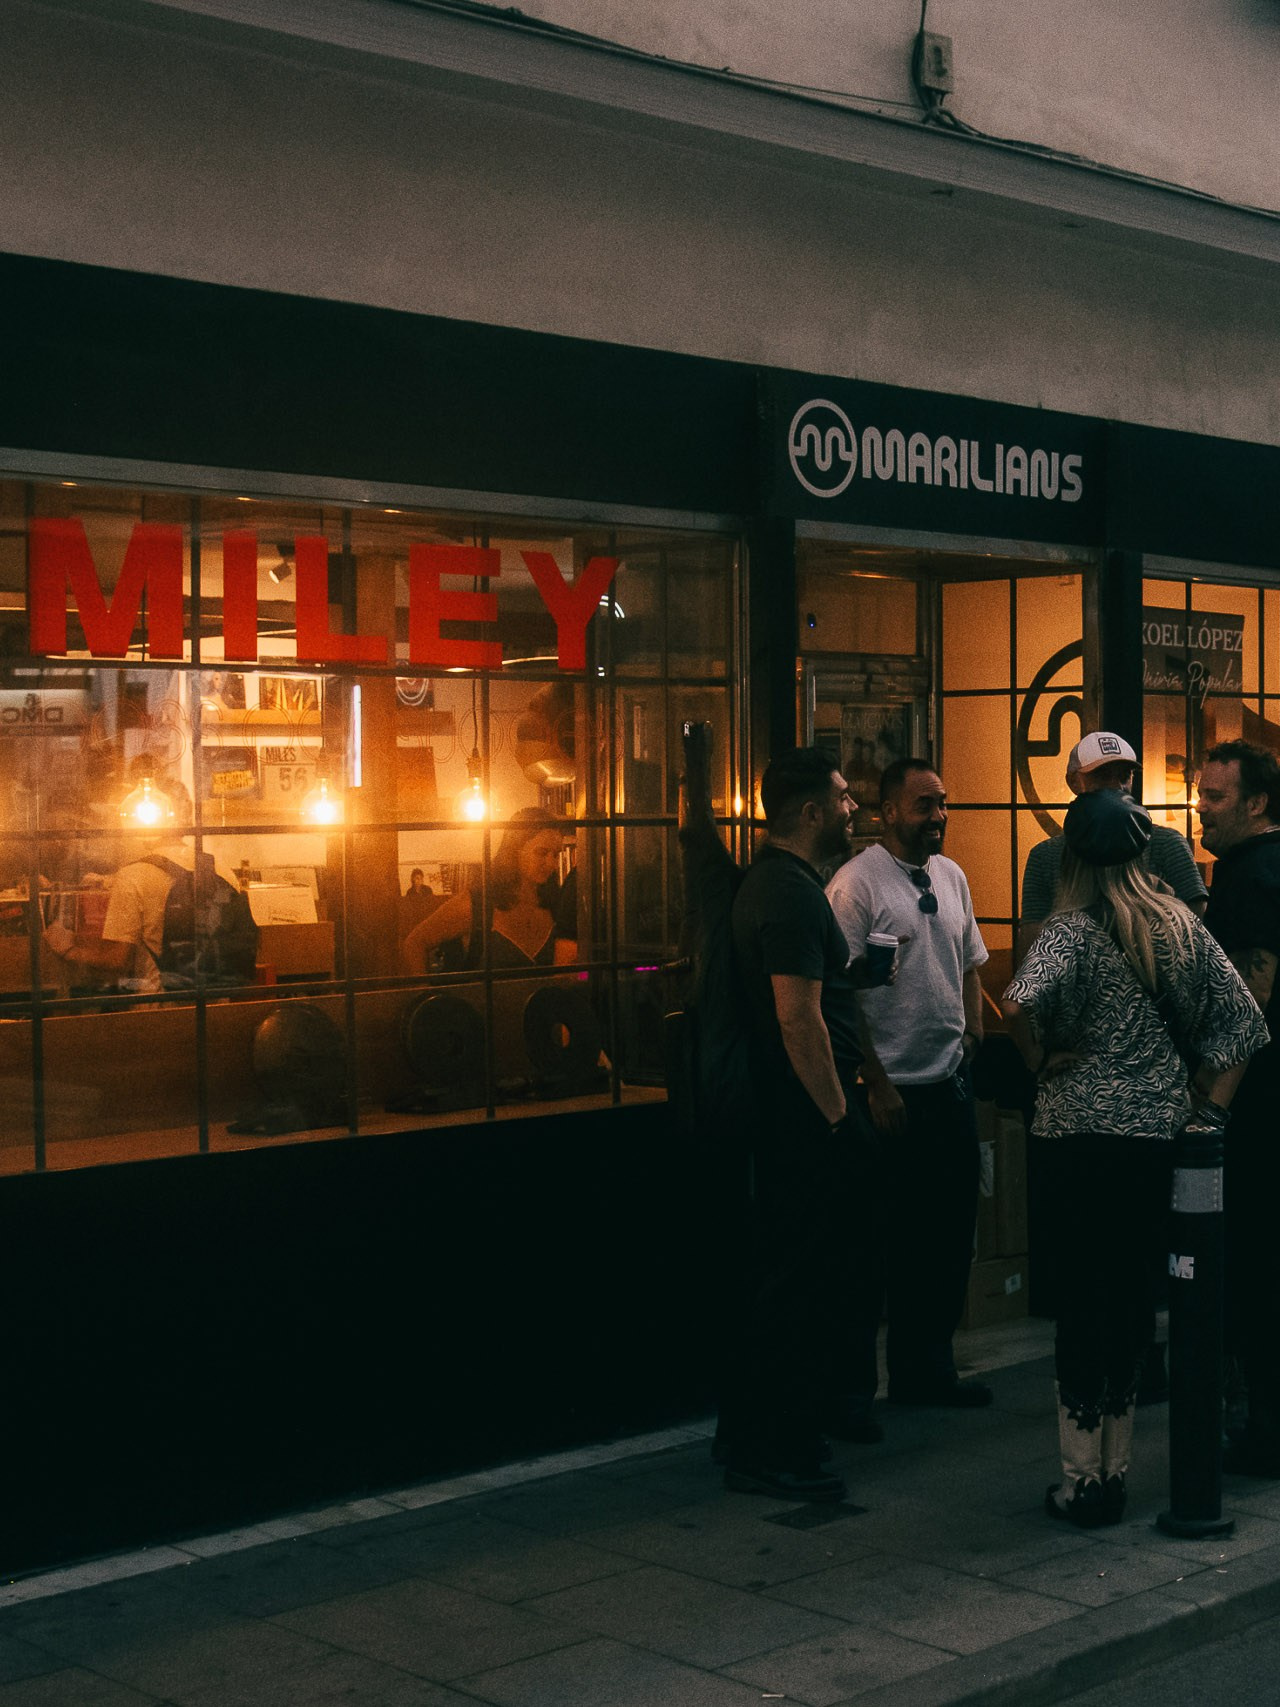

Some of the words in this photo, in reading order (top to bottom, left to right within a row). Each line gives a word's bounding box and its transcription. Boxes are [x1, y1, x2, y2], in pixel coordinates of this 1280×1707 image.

[861, 426, 1083, 502] MARILIANS
[29, 517, 621, 671] MILEY
[1187, 619, 1243, 652] LÓPEZ
